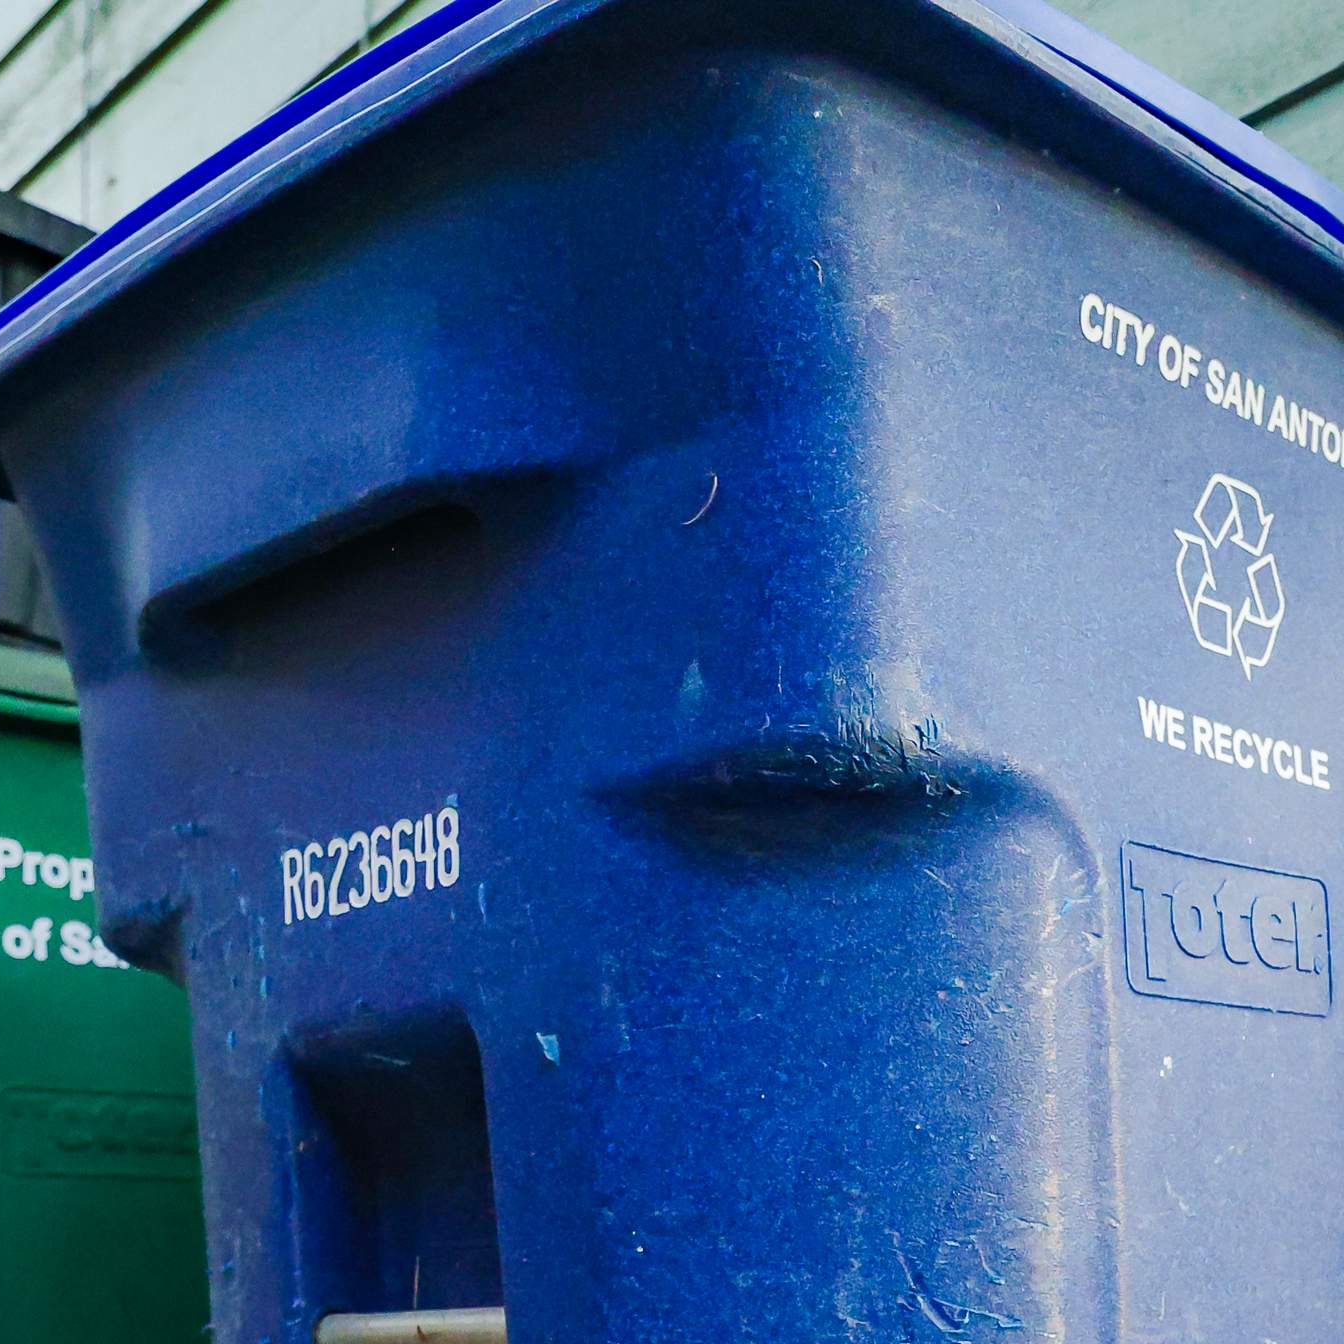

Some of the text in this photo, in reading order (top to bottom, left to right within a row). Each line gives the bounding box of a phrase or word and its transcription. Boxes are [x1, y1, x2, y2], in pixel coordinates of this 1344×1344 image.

[1080, 293, 1156, 367] CITY
[1158, 334, 1202, 388] OF
[1205, 358, 1265, 426] SAN
[1137, 696, 1331, 790] WE RECYCLE
[281, 806, 461, 926] R6236648
[2, 917, 53, 962] of
[59, 920, 130, 970] Sa
